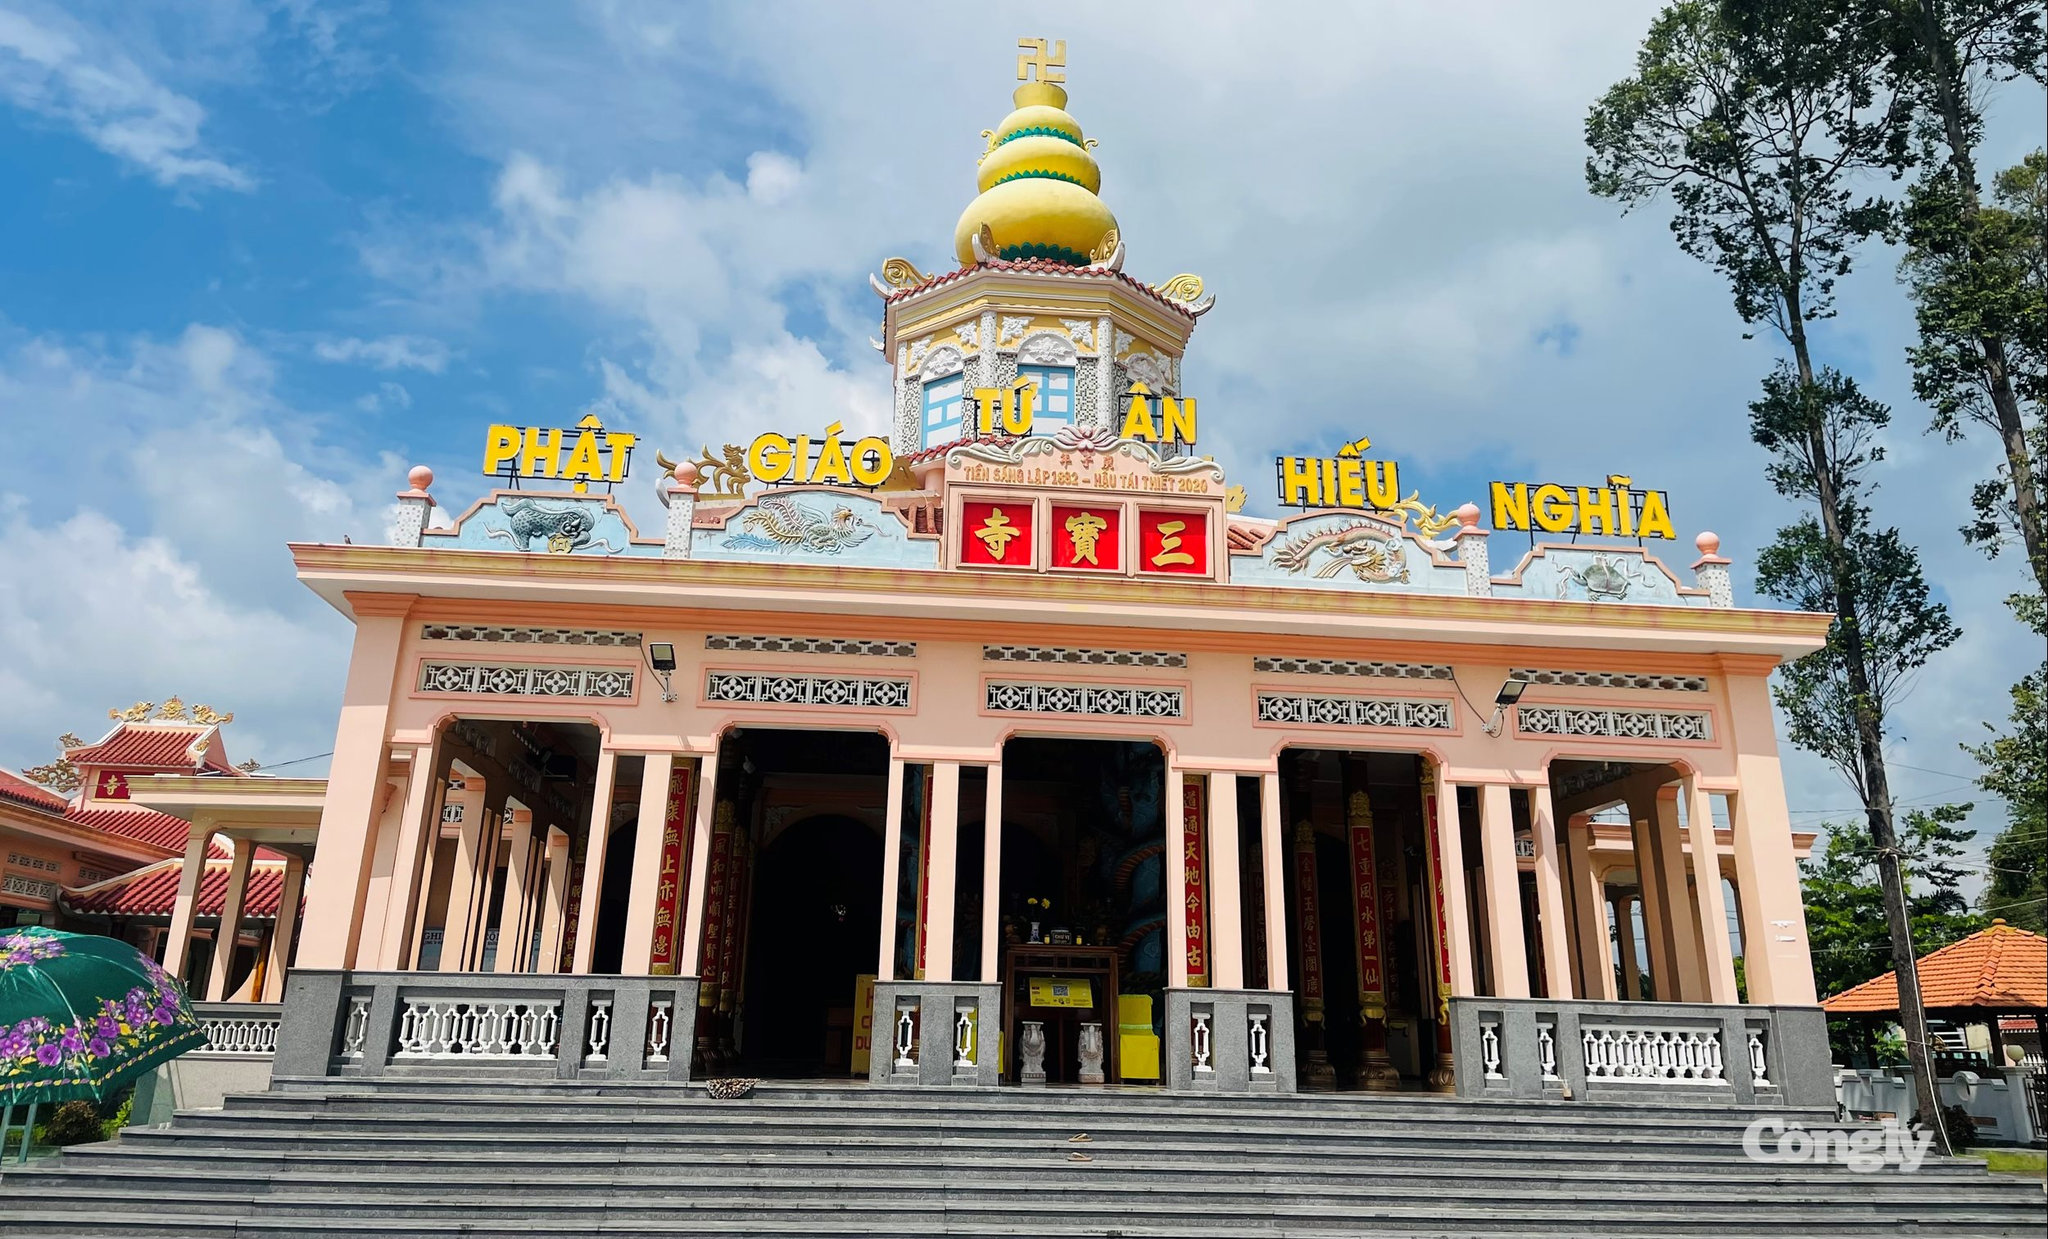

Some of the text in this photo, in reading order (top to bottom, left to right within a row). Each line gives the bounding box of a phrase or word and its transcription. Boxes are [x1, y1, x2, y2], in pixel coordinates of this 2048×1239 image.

[483, 375, 1677, 541] PHẬT GIÁO TỨ ÂN HIẾU NGHĨA
[993, 464, 1024, 483] SÁNG
[1027, 468, 1050, 486] LẬP
[1120, 472, 1139, 489] TÁI
[1178, 478, 1208, 494] 2020
